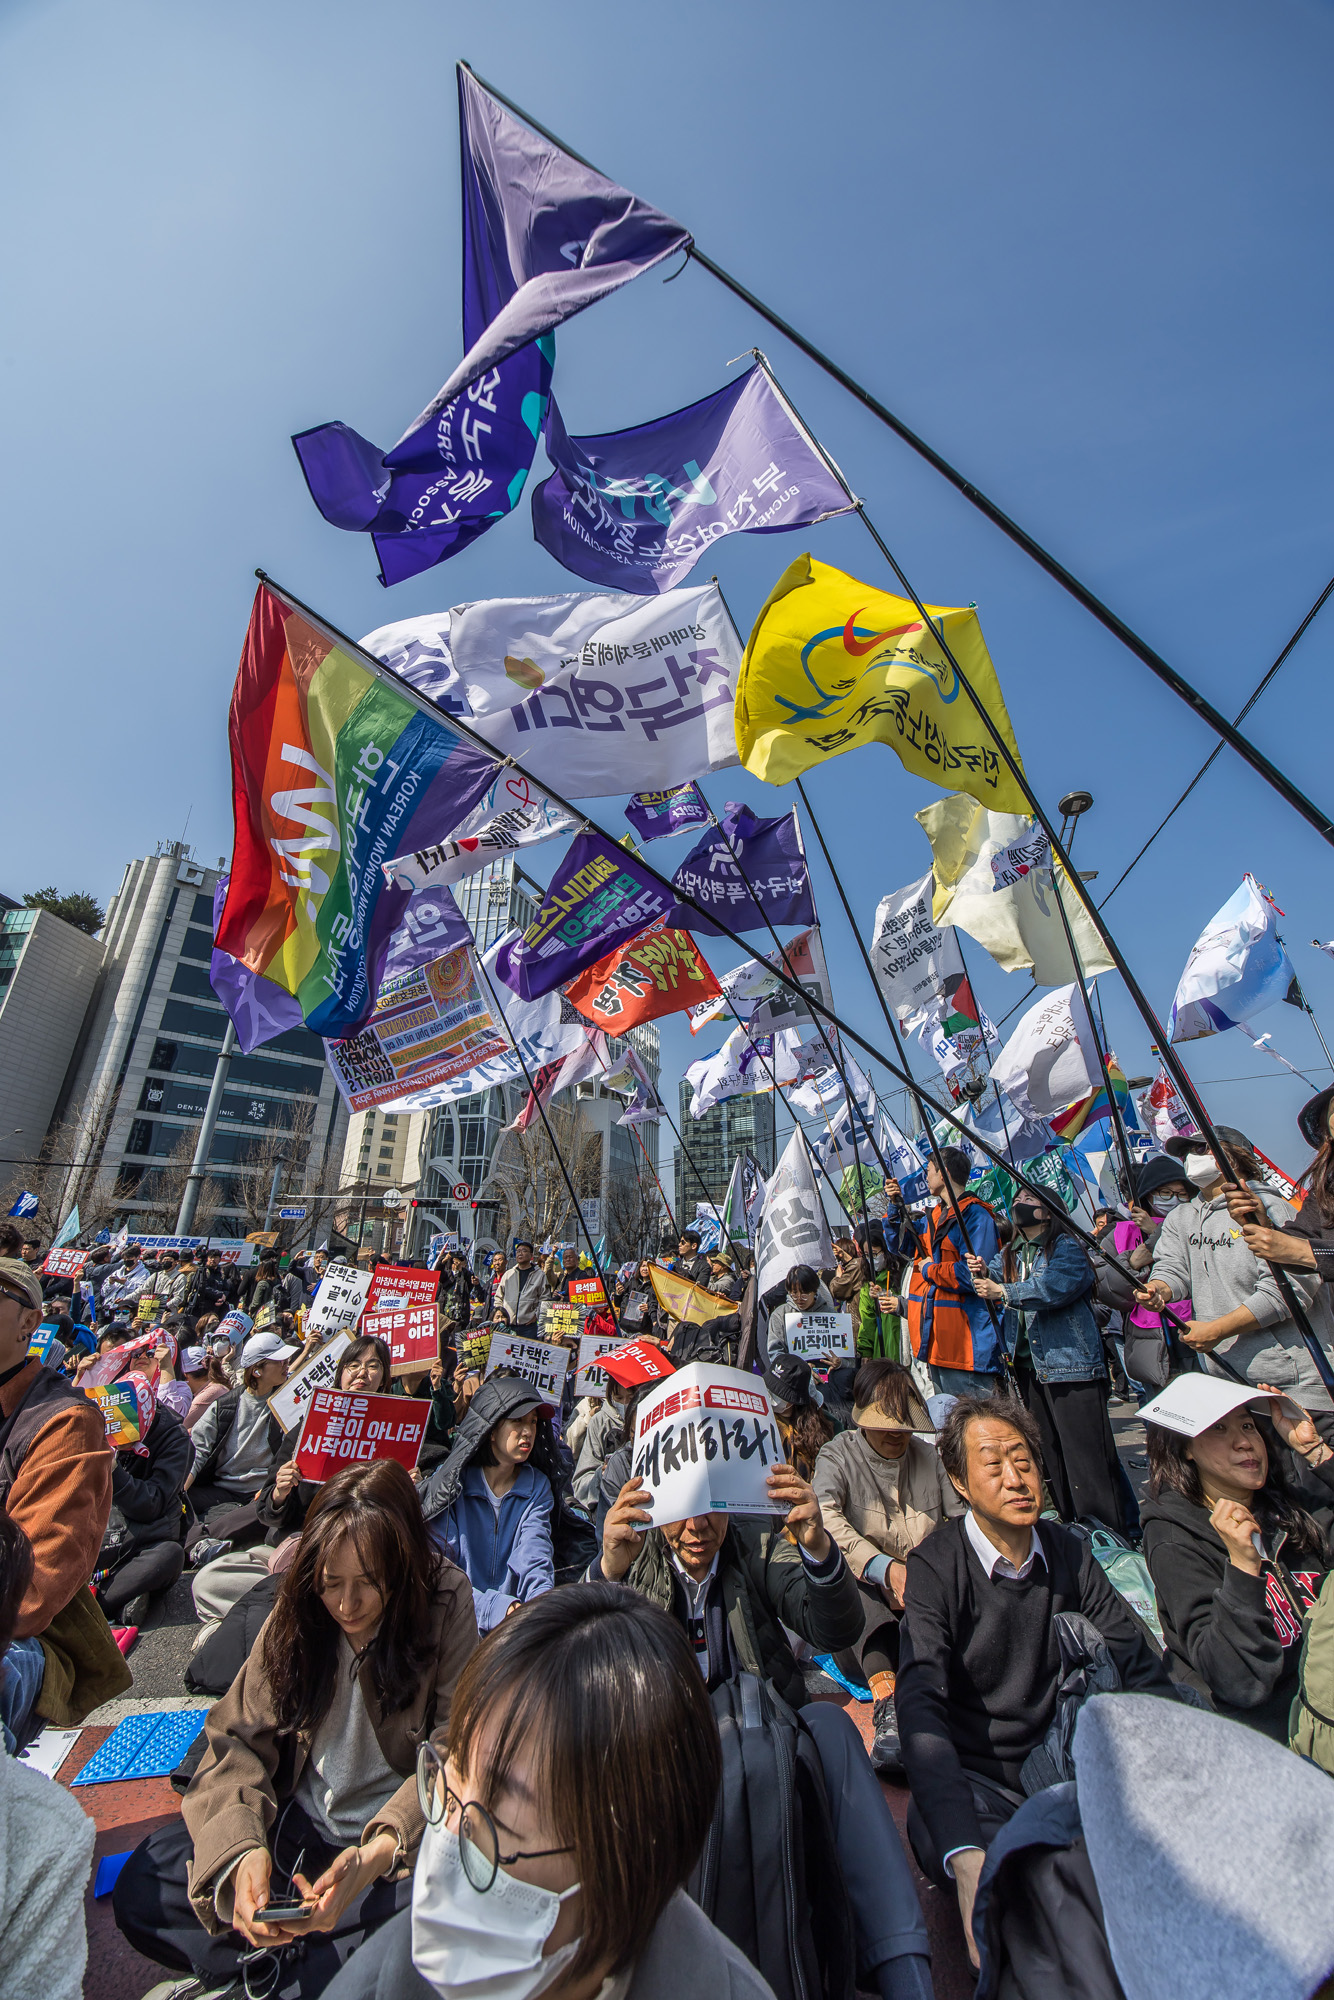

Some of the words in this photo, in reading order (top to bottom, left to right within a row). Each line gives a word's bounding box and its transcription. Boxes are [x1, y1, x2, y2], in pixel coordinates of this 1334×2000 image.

[50, 1248, 86, 1264] 윤석열
[47, 1260, 76, 1275] 파면!
[328, 1265, 358, 1285] 탄핵은
[375, 1276, 398, 1287] 마침내
[398, 1278, 420, 1290] 윤석열
[420, 1281, 436, 1292] 파면
[575, 1282, 598, 1293] 윤석열
[327, 1285, 351, 1303] 끝이
[403, 1291, 433, 1303] 새나라로
[586, 1291, 607, 1304] 파면!
[322, 1306, 357, 1325] 아니라
[366, 1313, 406, 1332] 탄핵은
[409, 1308, 435, 1326] 시작
[801, 1315, 836, 1329] 탄핵은
[408, 1325, 435, 1341] 이다
[793, 1333, 848, 1351] 시작이다
[510, 1343, 551, 1366] 탄핵은
[625, 1345, 662, 1377] 아니라
[293, 1354, 339, 1401] 탄핵은
[100, 1391, 131, 1409] 차별도
[313, 1393, 370, 1418] 탄핵은
[711, 1388, 764, 1413] 국민의힘
[640, 1386, 702, 1438] 내란동조
[326, 1416, 365, 1436] 끝이
[367, 1421, 421, 1443] 아니라
[301, 1434, 377, 1461] 시작이다
[635, 1416, 779, 1488] 해체하라!
